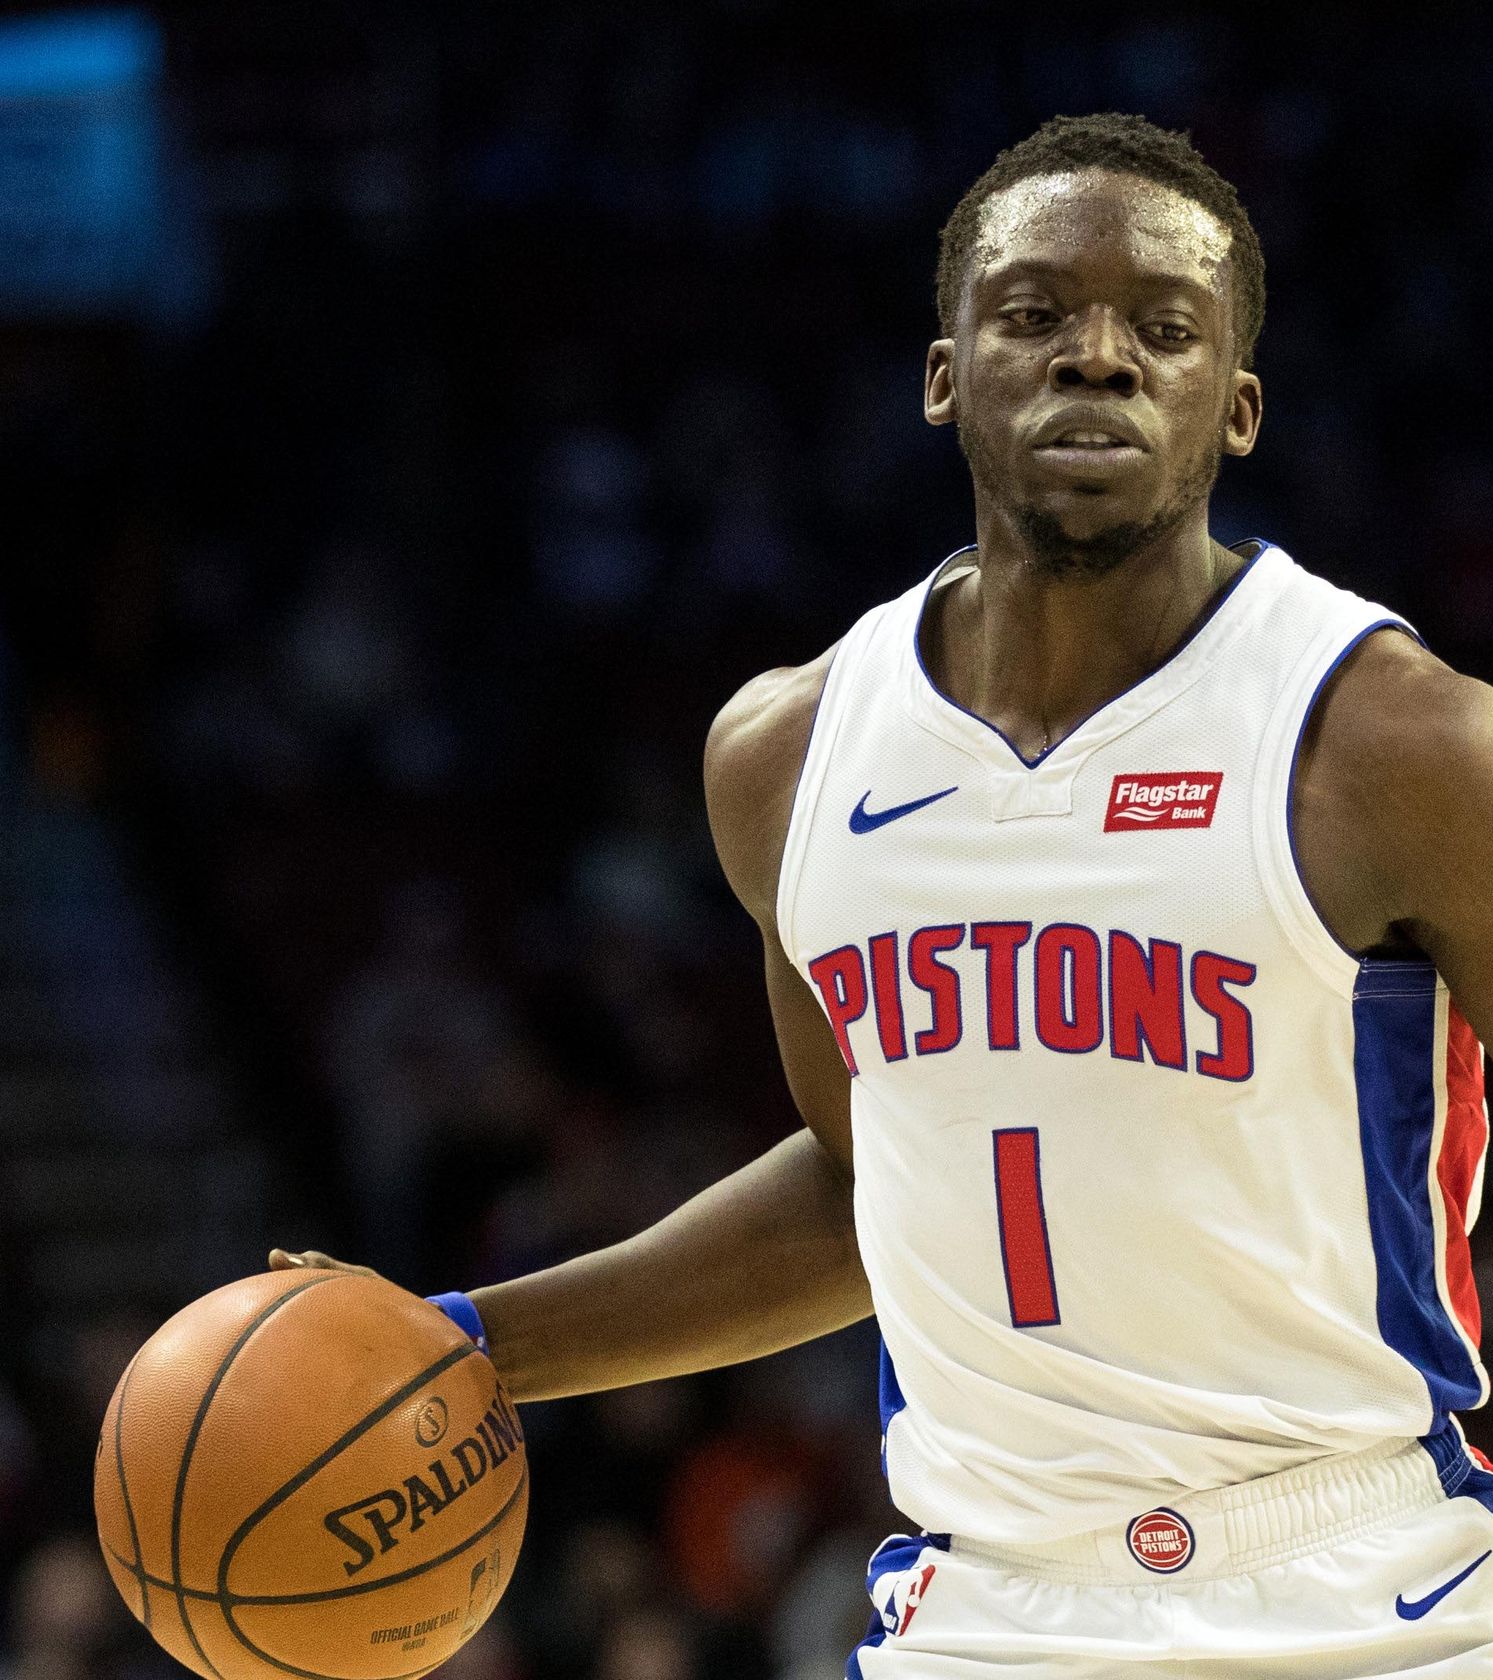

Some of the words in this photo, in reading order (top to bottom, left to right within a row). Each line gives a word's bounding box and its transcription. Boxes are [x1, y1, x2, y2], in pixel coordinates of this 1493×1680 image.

[1115, 779, 1214, 807] Flagstar
[1171, 806, 1207, 820] Bank
[808, 920, 1257, 1083] PISTONS
[992, 1126, 1062, 1328] 1
[1138, 1529, 1179, 1543] DETROIT
[1140, 1540, 1183, 1554] PISTONS
[370, 1625, 412, 1645] OFFICIAL
[413, 1615, 439, 1637] GAME
